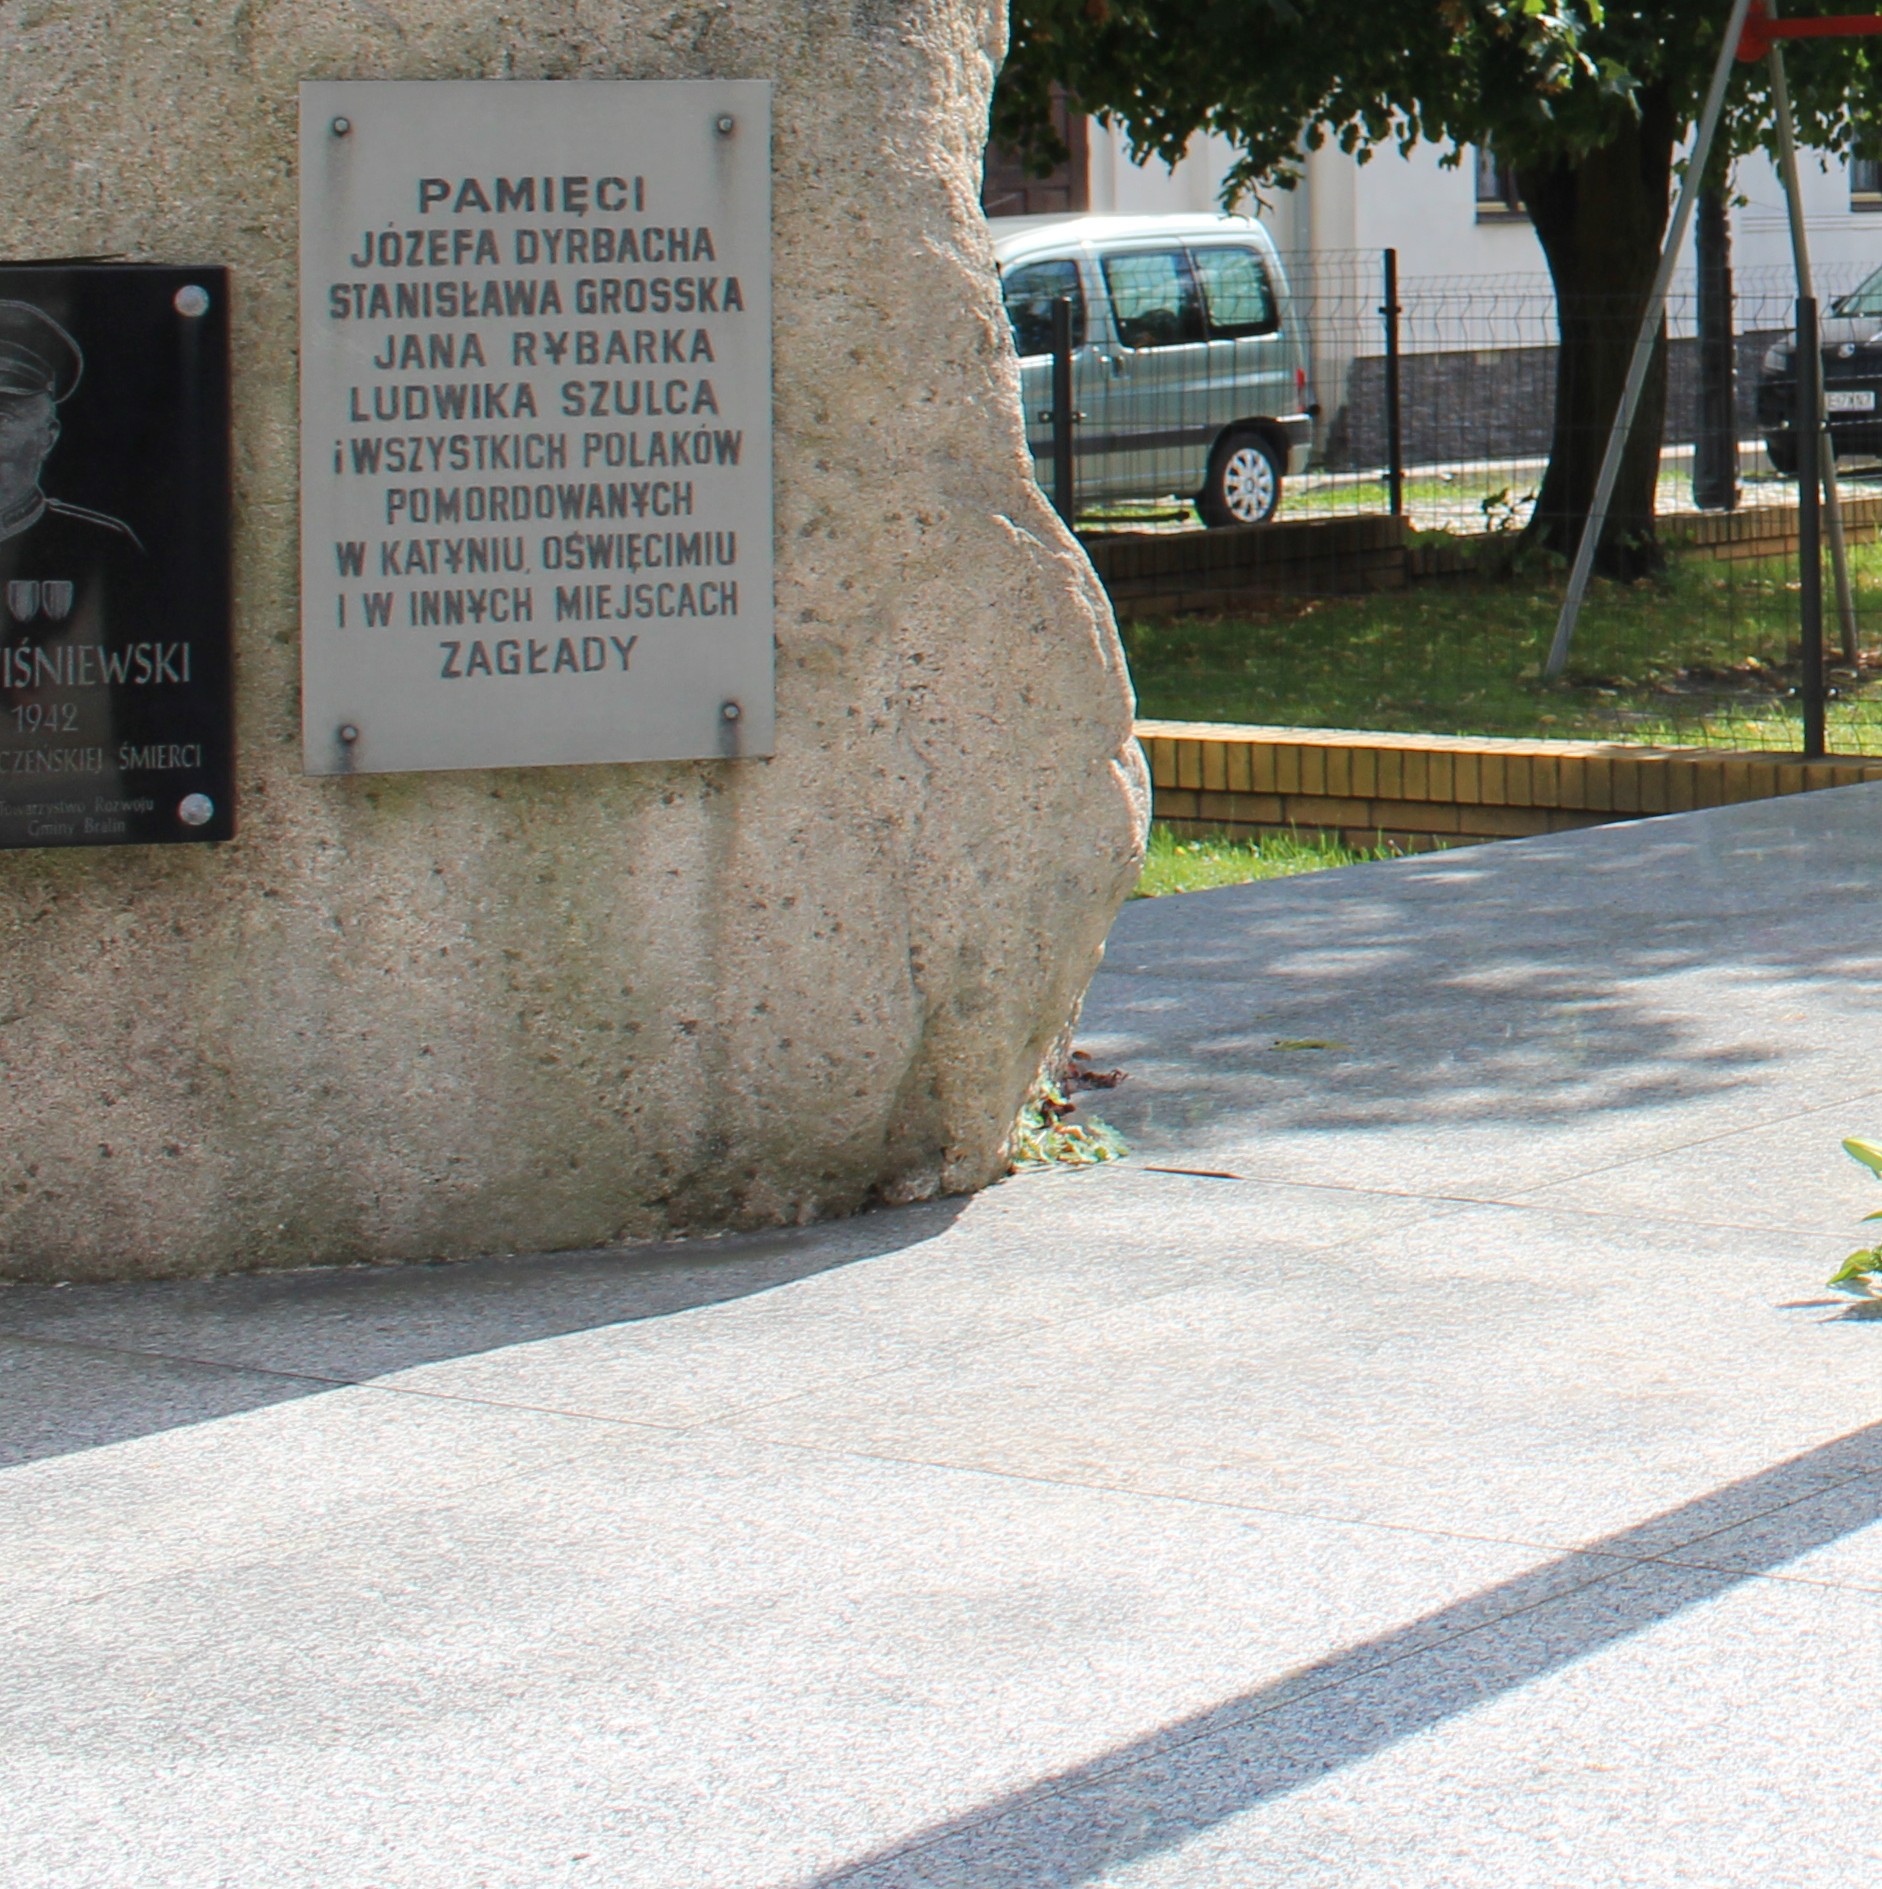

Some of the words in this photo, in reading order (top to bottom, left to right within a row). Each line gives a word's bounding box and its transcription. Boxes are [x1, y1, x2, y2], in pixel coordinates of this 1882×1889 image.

[418, 175, 645, 218] PAMIĘCI
[350, 221, 500, 269] JÓZEFA
[515, 226, 716, 266] DYRBACHA
[329, 279, 563, 321] STANISŁAWA
[575, 276, 745, 315] GROSSKA
[373, 332, 486, 370] JANA
[512, 328, 715, 367] RYBARKA
[350, 382, 538, 423] LUDWIKA
[561, 378, 720, 417] SZULCA
[349, 433, 567, 476] WSZYSTKICH
[583, 423, 743, 468] POLAKÓW
[386, 481, 693, 526] POMORDOWANYCH
[335, 541, 367, 578] W
[542, 530, 737, 574] OŚWIĘCIMIU
[338, 593, 347, 629] I
[362, 591, 394, 628] W
[409, 587, 533, 627] INNYCH
[555, 580, 738, 623] MIEJSCACH
[0, 636, 192, 688] IŚNIEWSKI
[439, 635, 638, 680] ZAGŁADY
[11, 702, 79, 733] 1942
[118, 740, 202, 771] ŚMIERCI
[94, 795, 155, 816] Rozwoju
